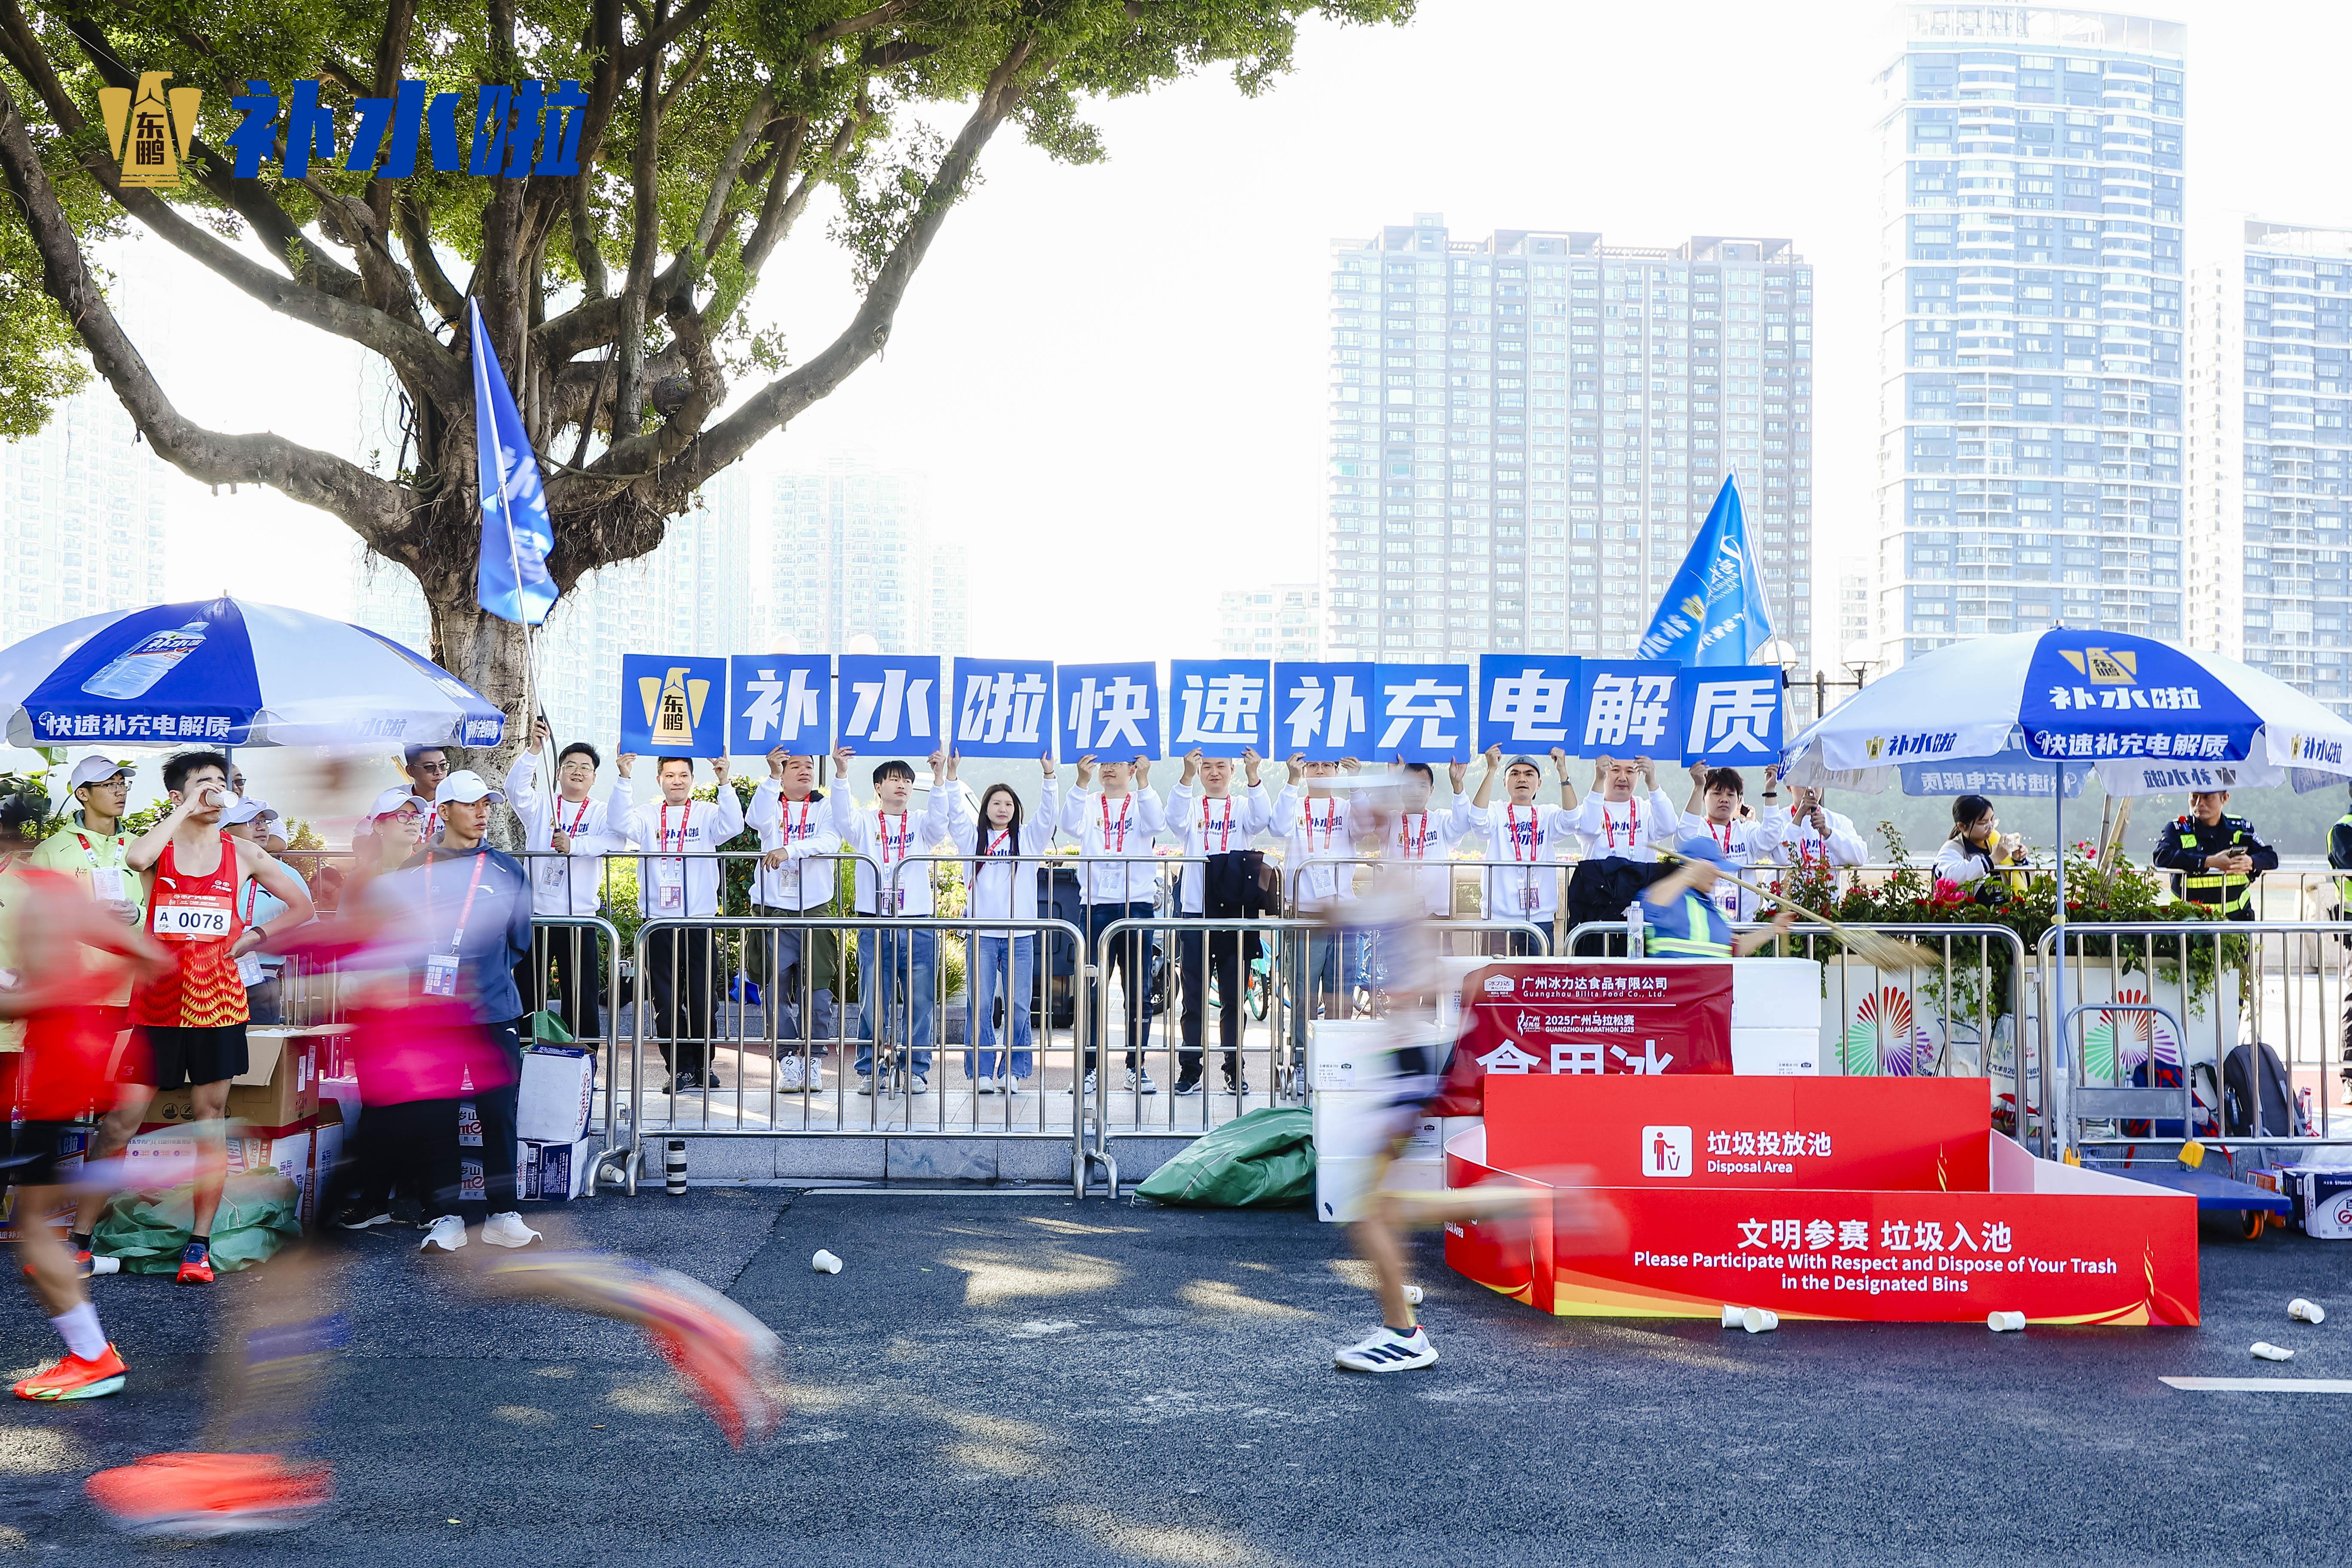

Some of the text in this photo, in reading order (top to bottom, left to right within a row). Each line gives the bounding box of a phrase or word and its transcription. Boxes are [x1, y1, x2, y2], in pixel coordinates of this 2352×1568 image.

[146, 639, 204, 649] 补水啦
[2049, 686, 2202, 710] 补水啦
[662, 694, 683, 731] 东鹏
[46, 714, 231, 737] 快速补充电解质
[350, 717, 408, 737] 水啦
[1888, 732, 1958, 756] 补水啦
[2041, 732, 2229, 757] 快速补充电解质
[2303, 737, 2343, 764] 补水啦
[160, 912, 224, 930] A 0078
[1522, 976, 1668, 990] 广州冰力达食品有限公司
[1523, 990, 1572, 999] Guangzhou
[1545, 1014, 1635, 1026] 2025广州马拉松赛
[459, 1111, 478, 1121] 岁山
[1707, 1131, 1831, 1157] 垃圾投放池
[1708, 1159, 1793, 1175] Disposal Area
[1737, 1218, 2012, 1253] 文明参赛 垃圾入池
[1635, 1251, 2116, 1276] Please Participate With Respect and Dispose of Your Trash
[1782, 1273, 1969, 1295] in the Designated Bins
